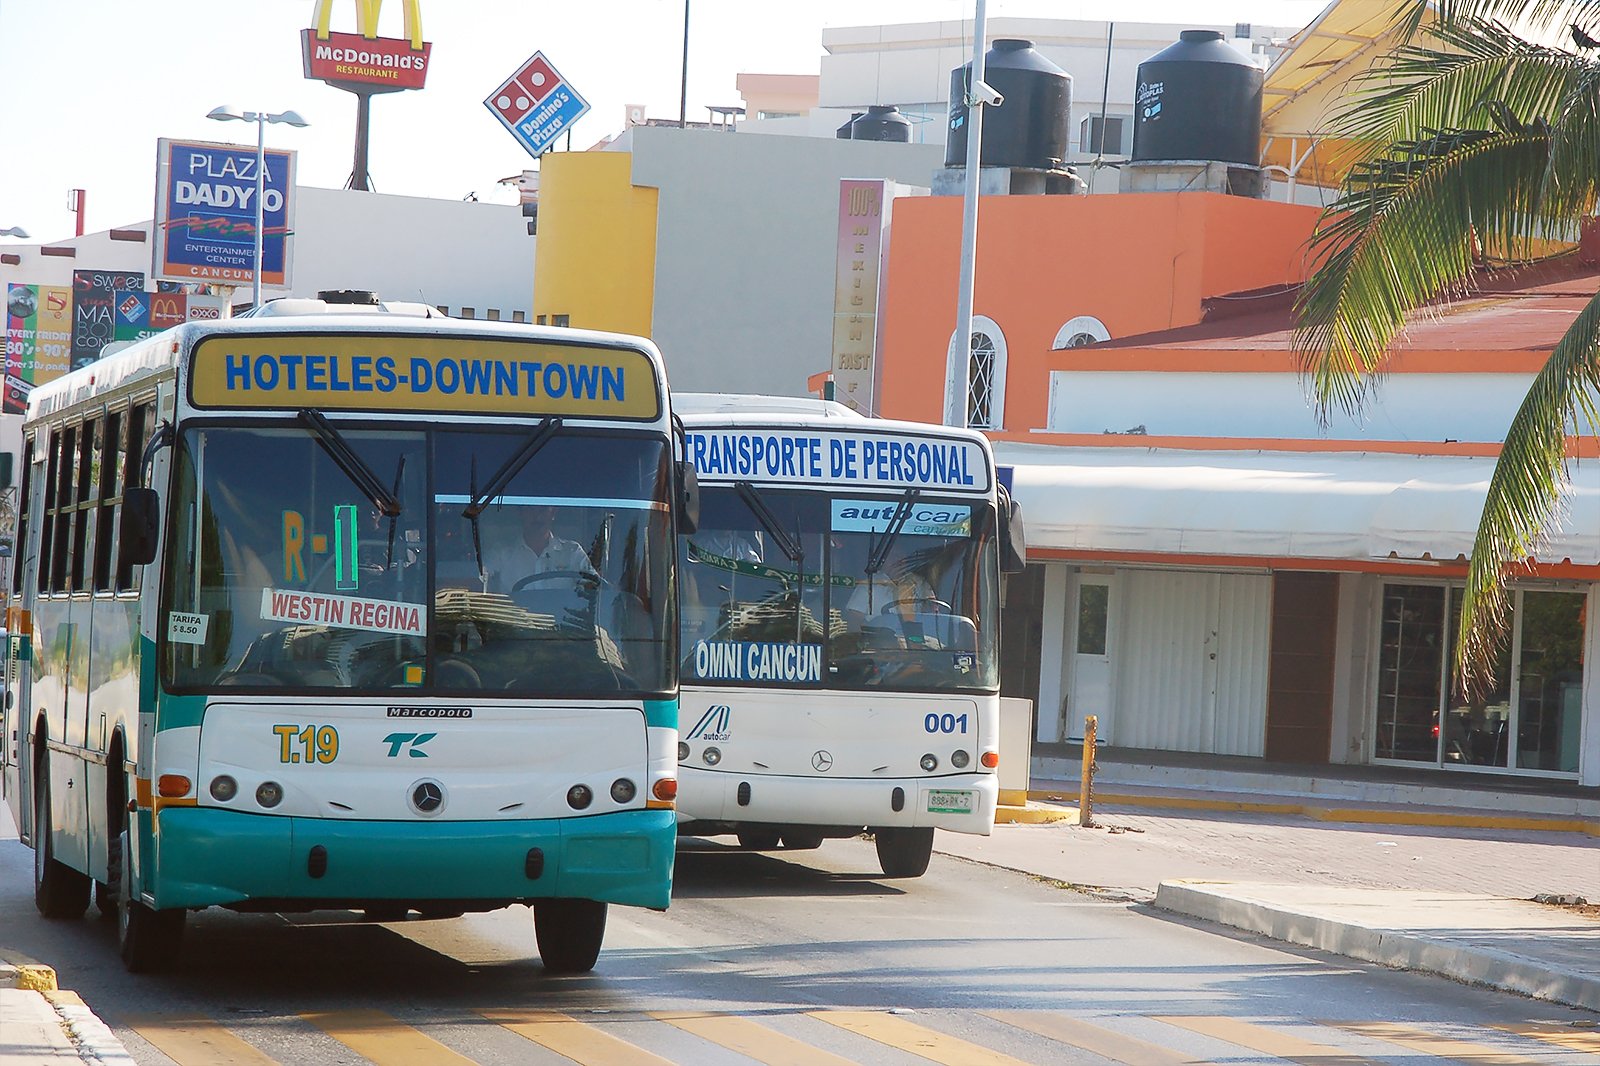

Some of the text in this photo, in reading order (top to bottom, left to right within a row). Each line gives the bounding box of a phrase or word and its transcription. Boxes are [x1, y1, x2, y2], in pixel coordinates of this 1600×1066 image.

[316, 46, 425, 70] McDonald's
[336, 65, 399, 79] RESTAURANTE
[521, 92, 569, 136] Domino's
[530, 117, 563, 147] Pizza
[190, 153, 272, 182] PLAZA
[175, 181, 284, 212] DADYO
[848, 186, 880, 217] 100%
[185, 244, 265, 257] ENTERTAINME
[206, 255, 246, 265] CENTER
[190, 267, 253, 279] CANCUN
[190, 308, 219, 318] OXXO
[7, 329, 35, 339] EVERY
[838, 353, 870, 370] FAST
[226, 355, 625, 401] HOTELES-DOWNTOWN
[685, 434, 974, 486] TRANSPORTE DE PERSONAL
[172, 614, 201, 624] TARIFA
[271, 592, 420, 632] WESTIN REGINA
[180, 625, 198, 634] 8.50
[696, 641, 821, 680] OMNI CANCUN
[389, 707, 471, 718] Marcopolo
[924, 713, 967, 734] 001
[273, 724, 340, 765] T.19
[703, 733, 730, 741] autocar
